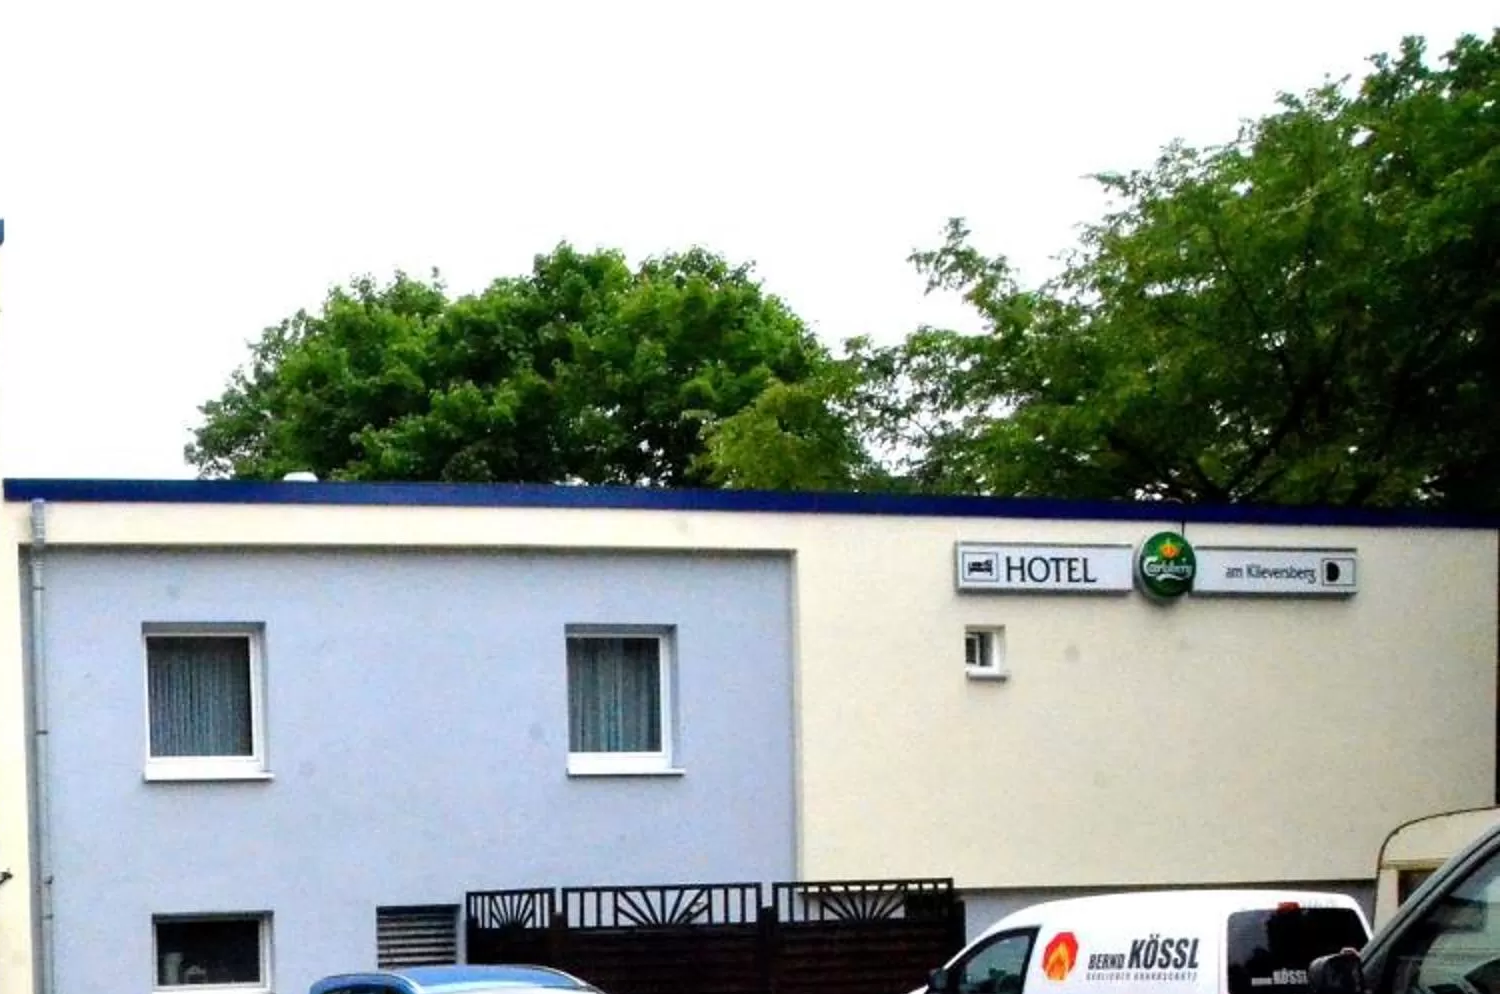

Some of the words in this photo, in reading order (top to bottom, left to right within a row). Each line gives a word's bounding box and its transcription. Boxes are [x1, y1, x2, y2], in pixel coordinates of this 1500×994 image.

[1005, 556, 1097, 584] HOTEL
[1143, 556, 1192, 578] Carlsberg
[1226, 567, 1243, 579] am
[1246, 564, 1317, 584] Klieversberg
[1087, 953, 1126, 970] BERND
[1127, 933, 1200, 970] KÖSSL
